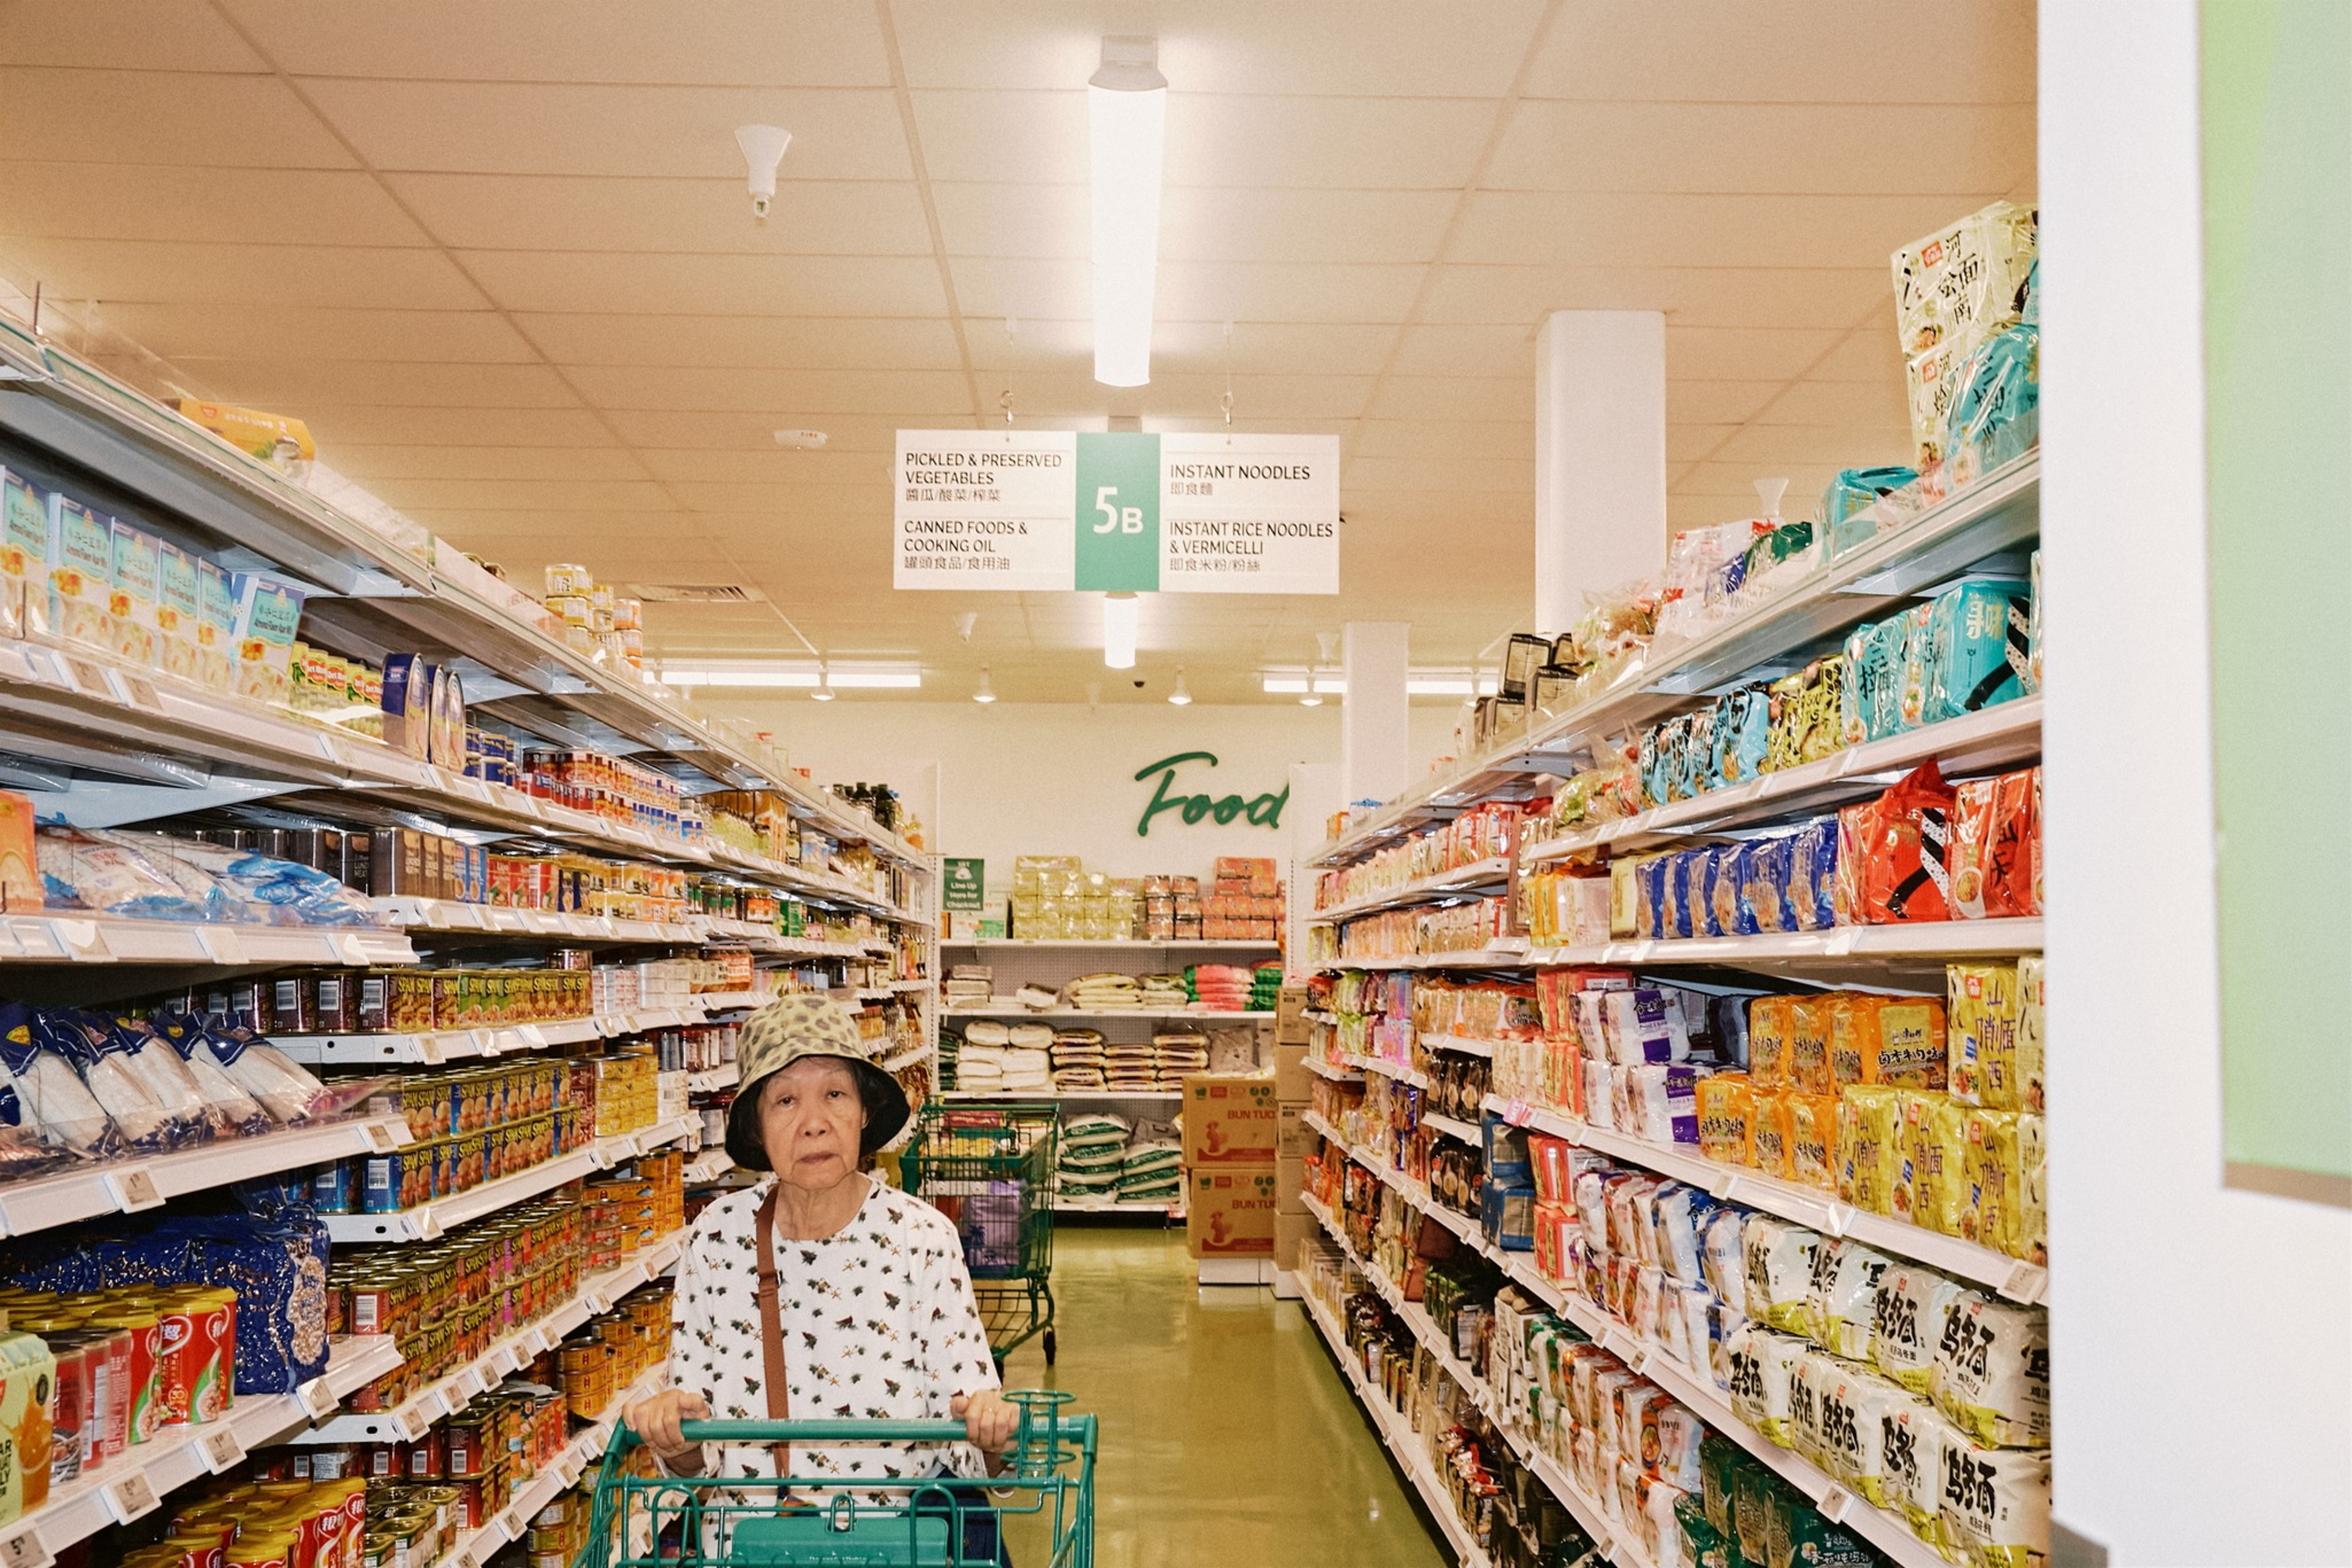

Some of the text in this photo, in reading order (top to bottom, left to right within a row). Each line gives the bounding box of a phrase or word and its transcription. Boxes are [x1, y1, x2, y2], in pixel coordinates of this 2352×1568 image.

[906, 453, 1062, 467] PICKLED & PRESERVED
[906, 470, 994, 484] VEGETABLES
[1170, 464, 1310, 480] INSTANT NOODLES
[1093, 486, 1144, 535] 5B
[904, 521, 1028, 535] CANNED FOODS &
[1170, 522, 1333, 537] INSTANT RICE NOODLES
[904, 538, 996, 552] COOKING OIL
[1170, 540, 1263, 554] & VERMICELLI
[904, 556, 1010, 570] 罐頭食品/食用油
[1170, 558, 1260, 572] 即食米粉/粉絲
[1134, 752, 1289, 836] Food
[1227, 1110, 1250, 1120] BUN
[1232, 1200, 1255, 1209] BUN
